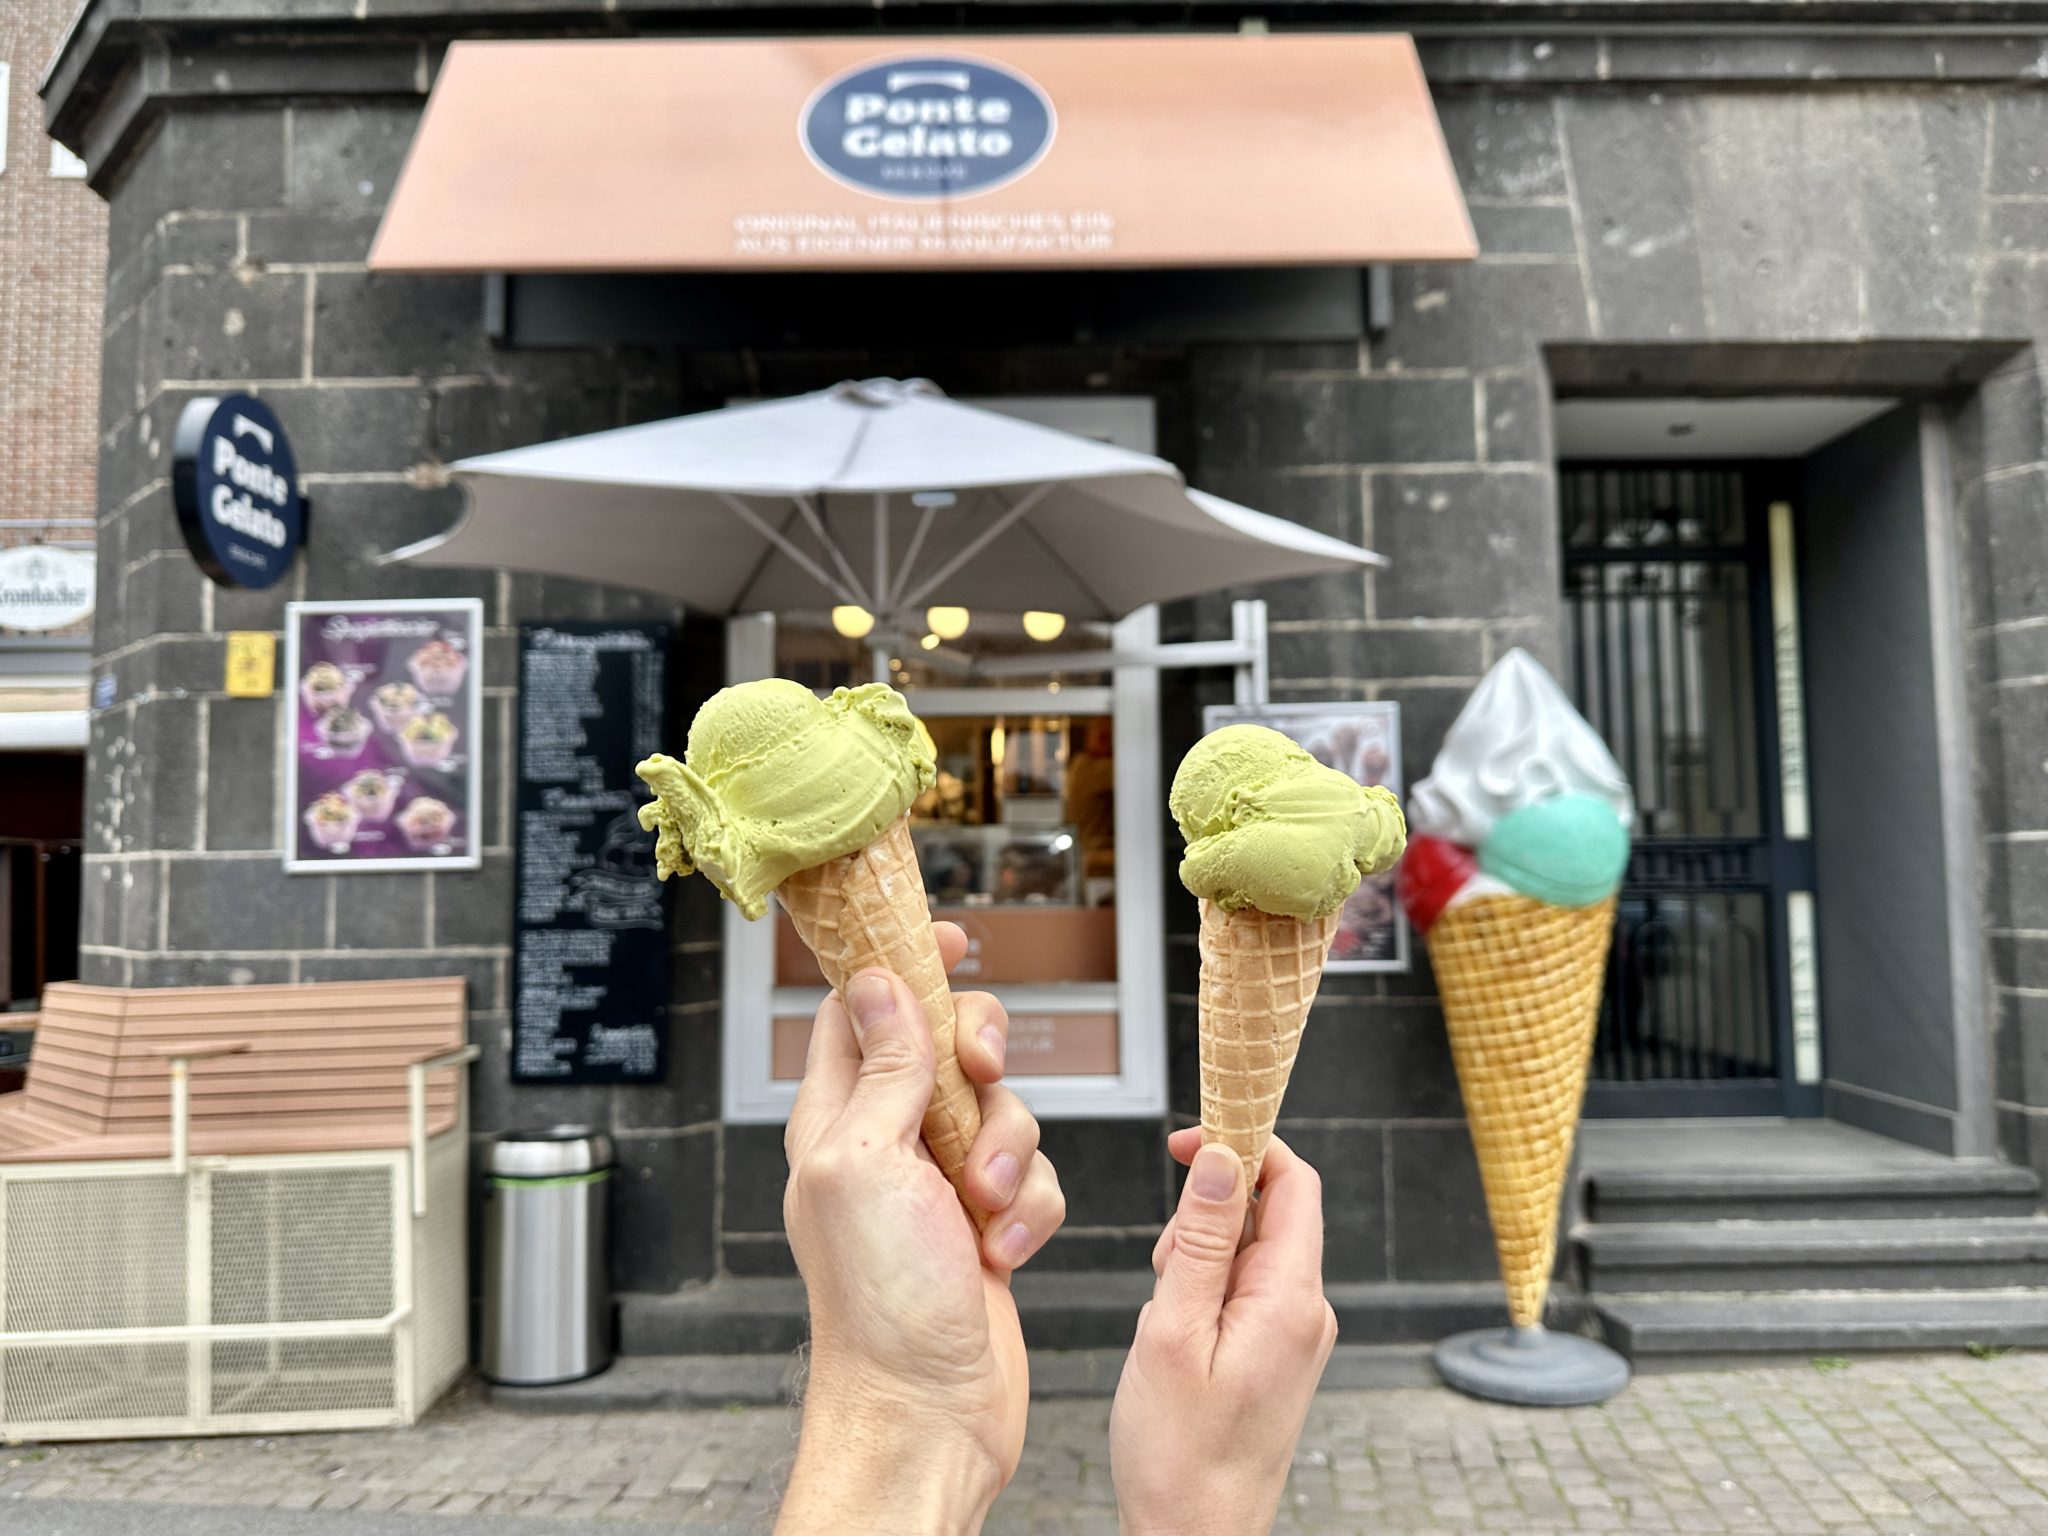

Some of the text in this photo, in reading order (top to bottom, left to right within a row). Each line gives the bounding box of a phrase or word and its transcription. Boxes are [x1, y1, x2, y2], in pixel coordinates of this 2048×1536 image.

[845, 92, 1012, 124] Ponte
[842, 125, 1013, 158] Gelato
[212, 434, 289, 506] Ponte
[211, 483, 287, 548] Gelato
[0, 580, 87, 607] rombacher
